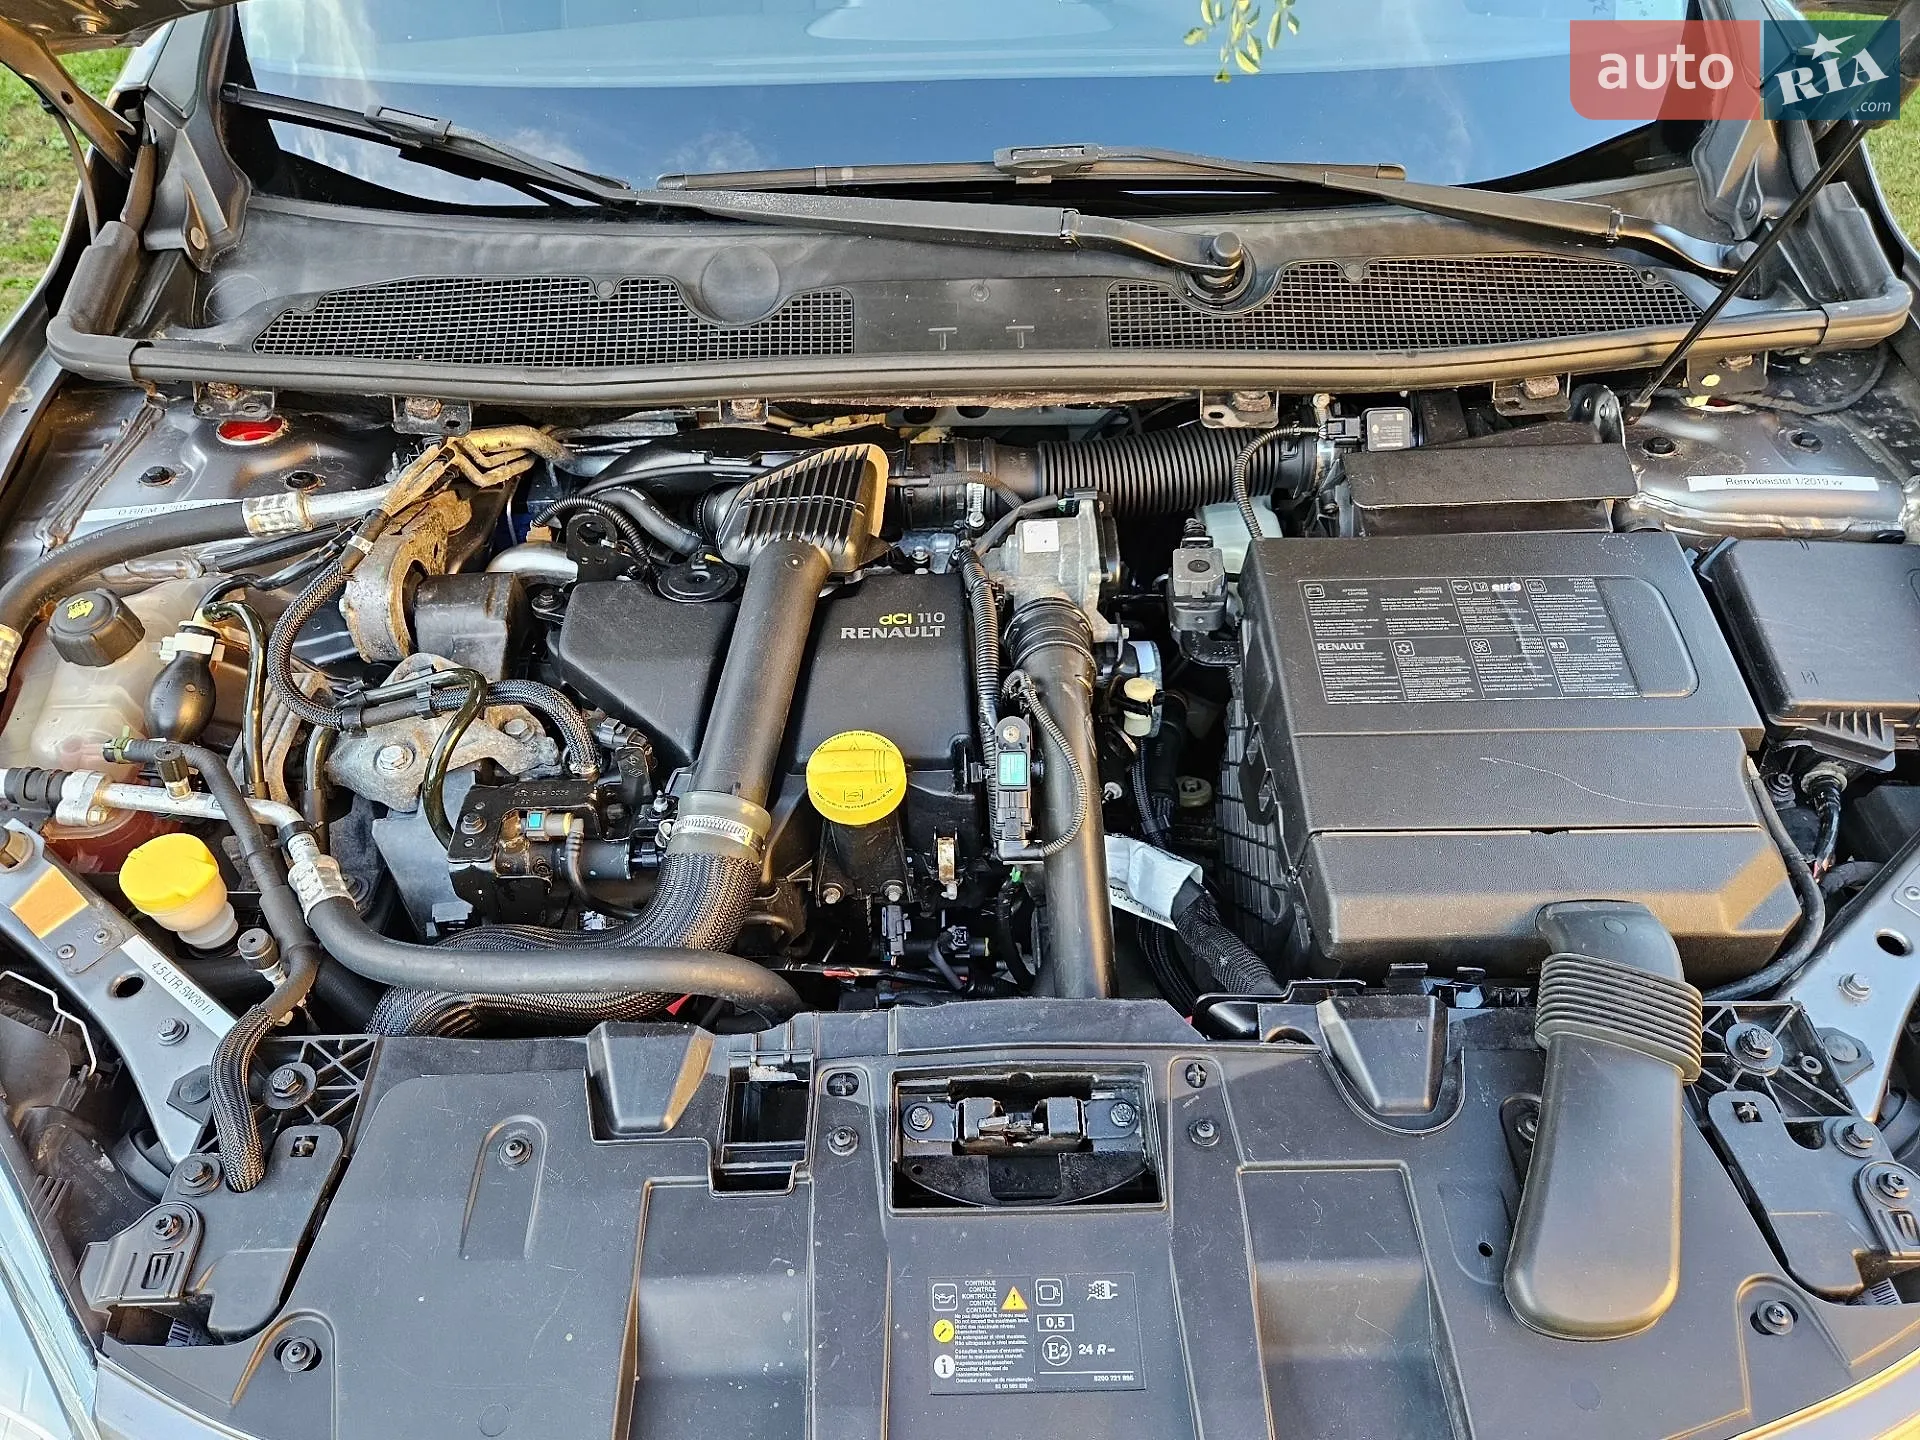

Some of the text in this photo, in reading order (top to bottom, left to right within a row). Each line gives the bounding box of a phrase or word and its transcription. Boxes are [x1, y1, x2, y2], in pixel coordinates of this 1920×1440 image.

[917, 612, 946, 623] 110
[840, 625, 946, 639] RENAULT
[1317, 642, 1366, 651] RENAULT
[1045, 1317, 1066, 1329] 0,5
[1047, 1342, 1069, 1360] E2
[1078, 1344, 1094, 1355] 24
